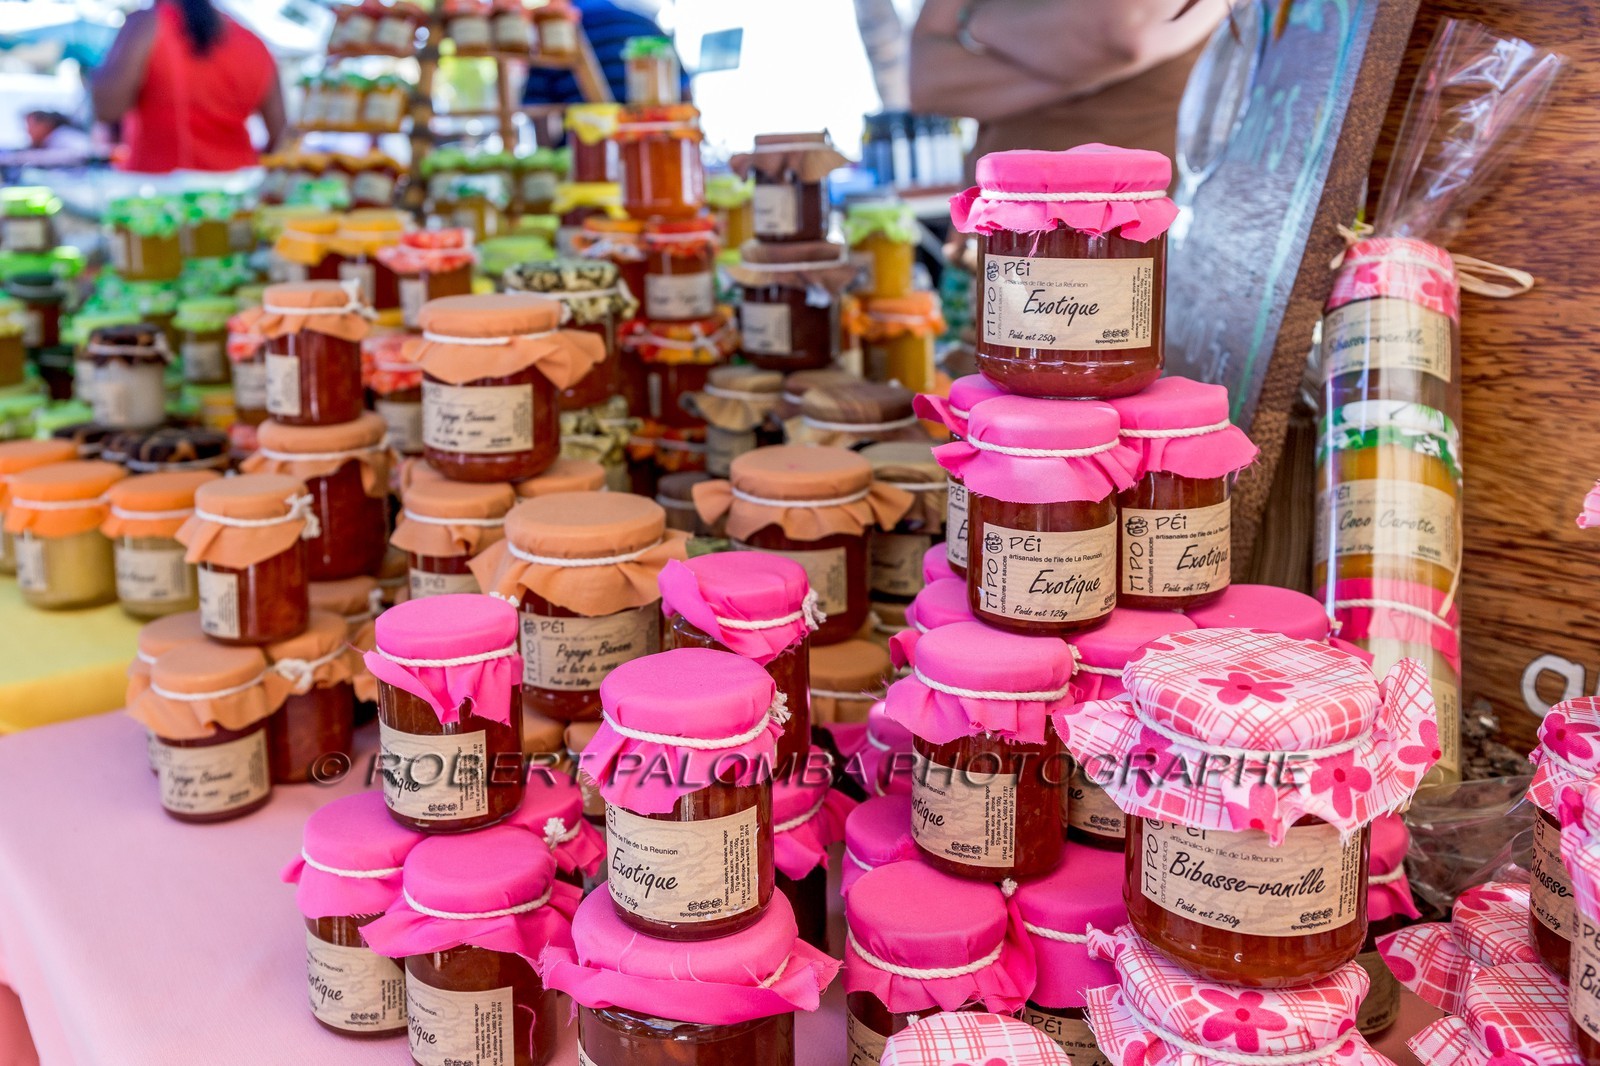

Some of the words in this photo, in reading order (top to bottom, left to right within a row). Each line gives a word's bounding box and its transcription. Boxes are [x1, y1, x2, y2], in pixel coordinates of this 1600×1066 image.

[1004, 259, 1030, 276] PÉi
[1023, 289, 1100, 326] Exotique
[1038, 334, 1056, 344] 250g
[1155, 513, 1186, 530] PÉi
[1340, 509, 1372, 530] Coco
[1379, 508, 1435, 534] Carotte
[1009, 536, 1042, 552] PÉi
[1009, 554, 1042, 562] artisanales
[1129, 542, 1144, 591] TiPO
[986, 558, 998, 608] TiPO
[1028, 569, 1100, 604] Exotique
[1162, 582, 1180, 592] Poids
[1196, 581, 1210, 592] 125g
[1014, 604, 1032, 616] Poids
[1050, 609, 1068, 620] 125g
[612, 847, 678, 898] Exotique
[1145, 834, 1158, 894] TiPO
[1170, 852, 1326, 898] Bibasse-vanille
[624, 895, 639, 910] 125g
[1176, 898, 1197, 914] Poids
[1199, 910, 1214, 918] net
[1216, 913, 1240, 928] 250g
[1546, 912, 1561, 930] 125g
[1030, 1015, 1062, 1035] PÉi
